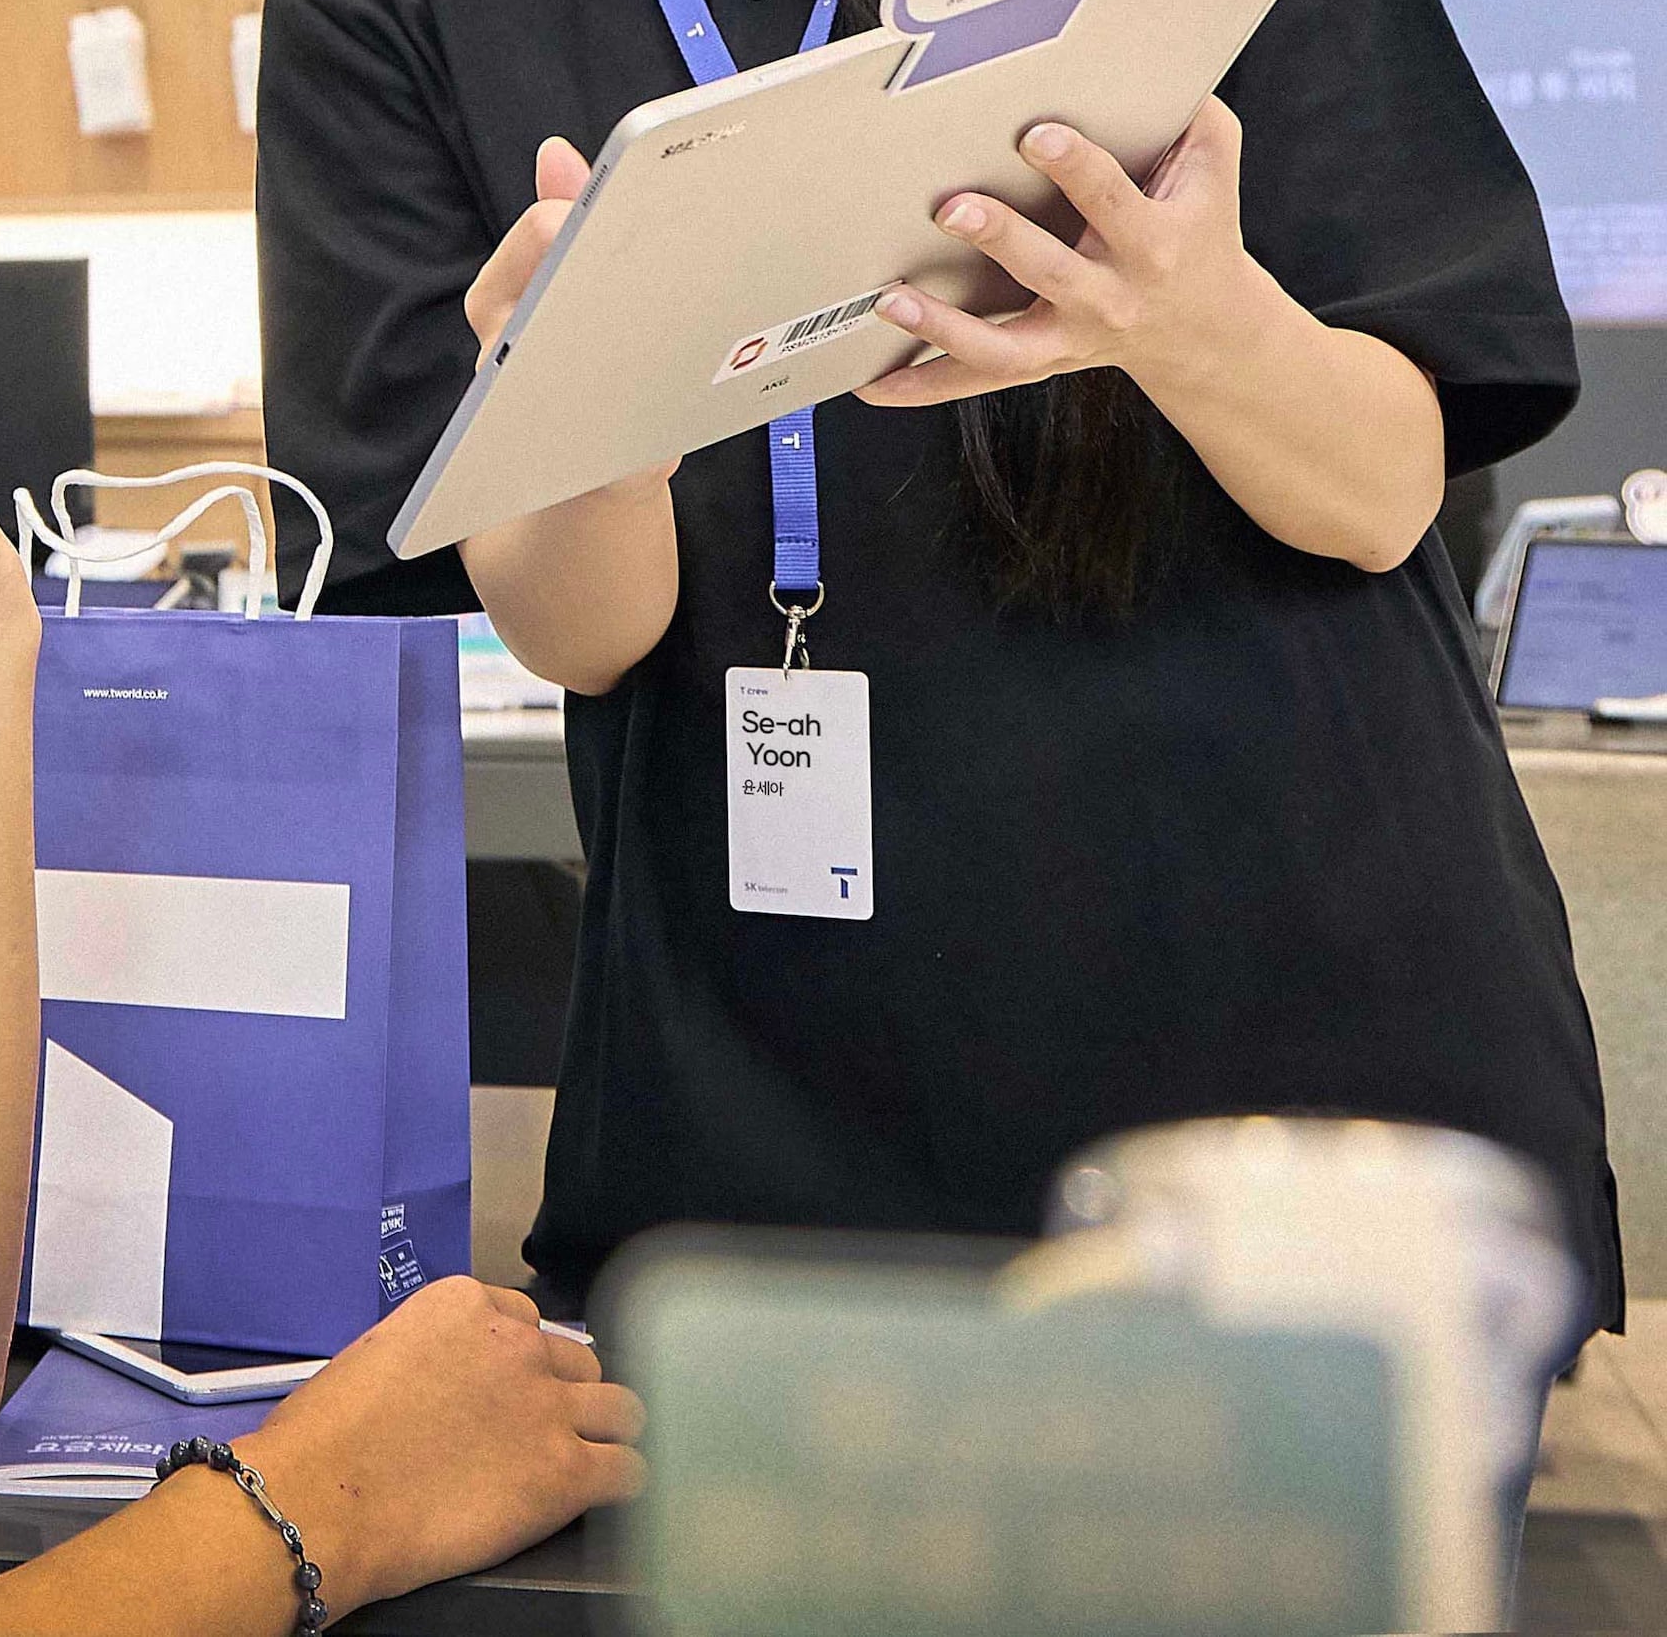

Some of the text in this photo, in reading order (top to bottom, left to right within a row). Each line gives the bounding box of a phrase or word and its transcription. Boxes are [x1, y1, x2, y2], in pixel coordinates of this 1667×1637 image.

[83, 688, 169, 699] www.tworld.co.kr
[741, 710, 821, 737] Se-ah
[746, 742, 811, 768] Yoon
[742, 779, 785, 797] 윤세아
